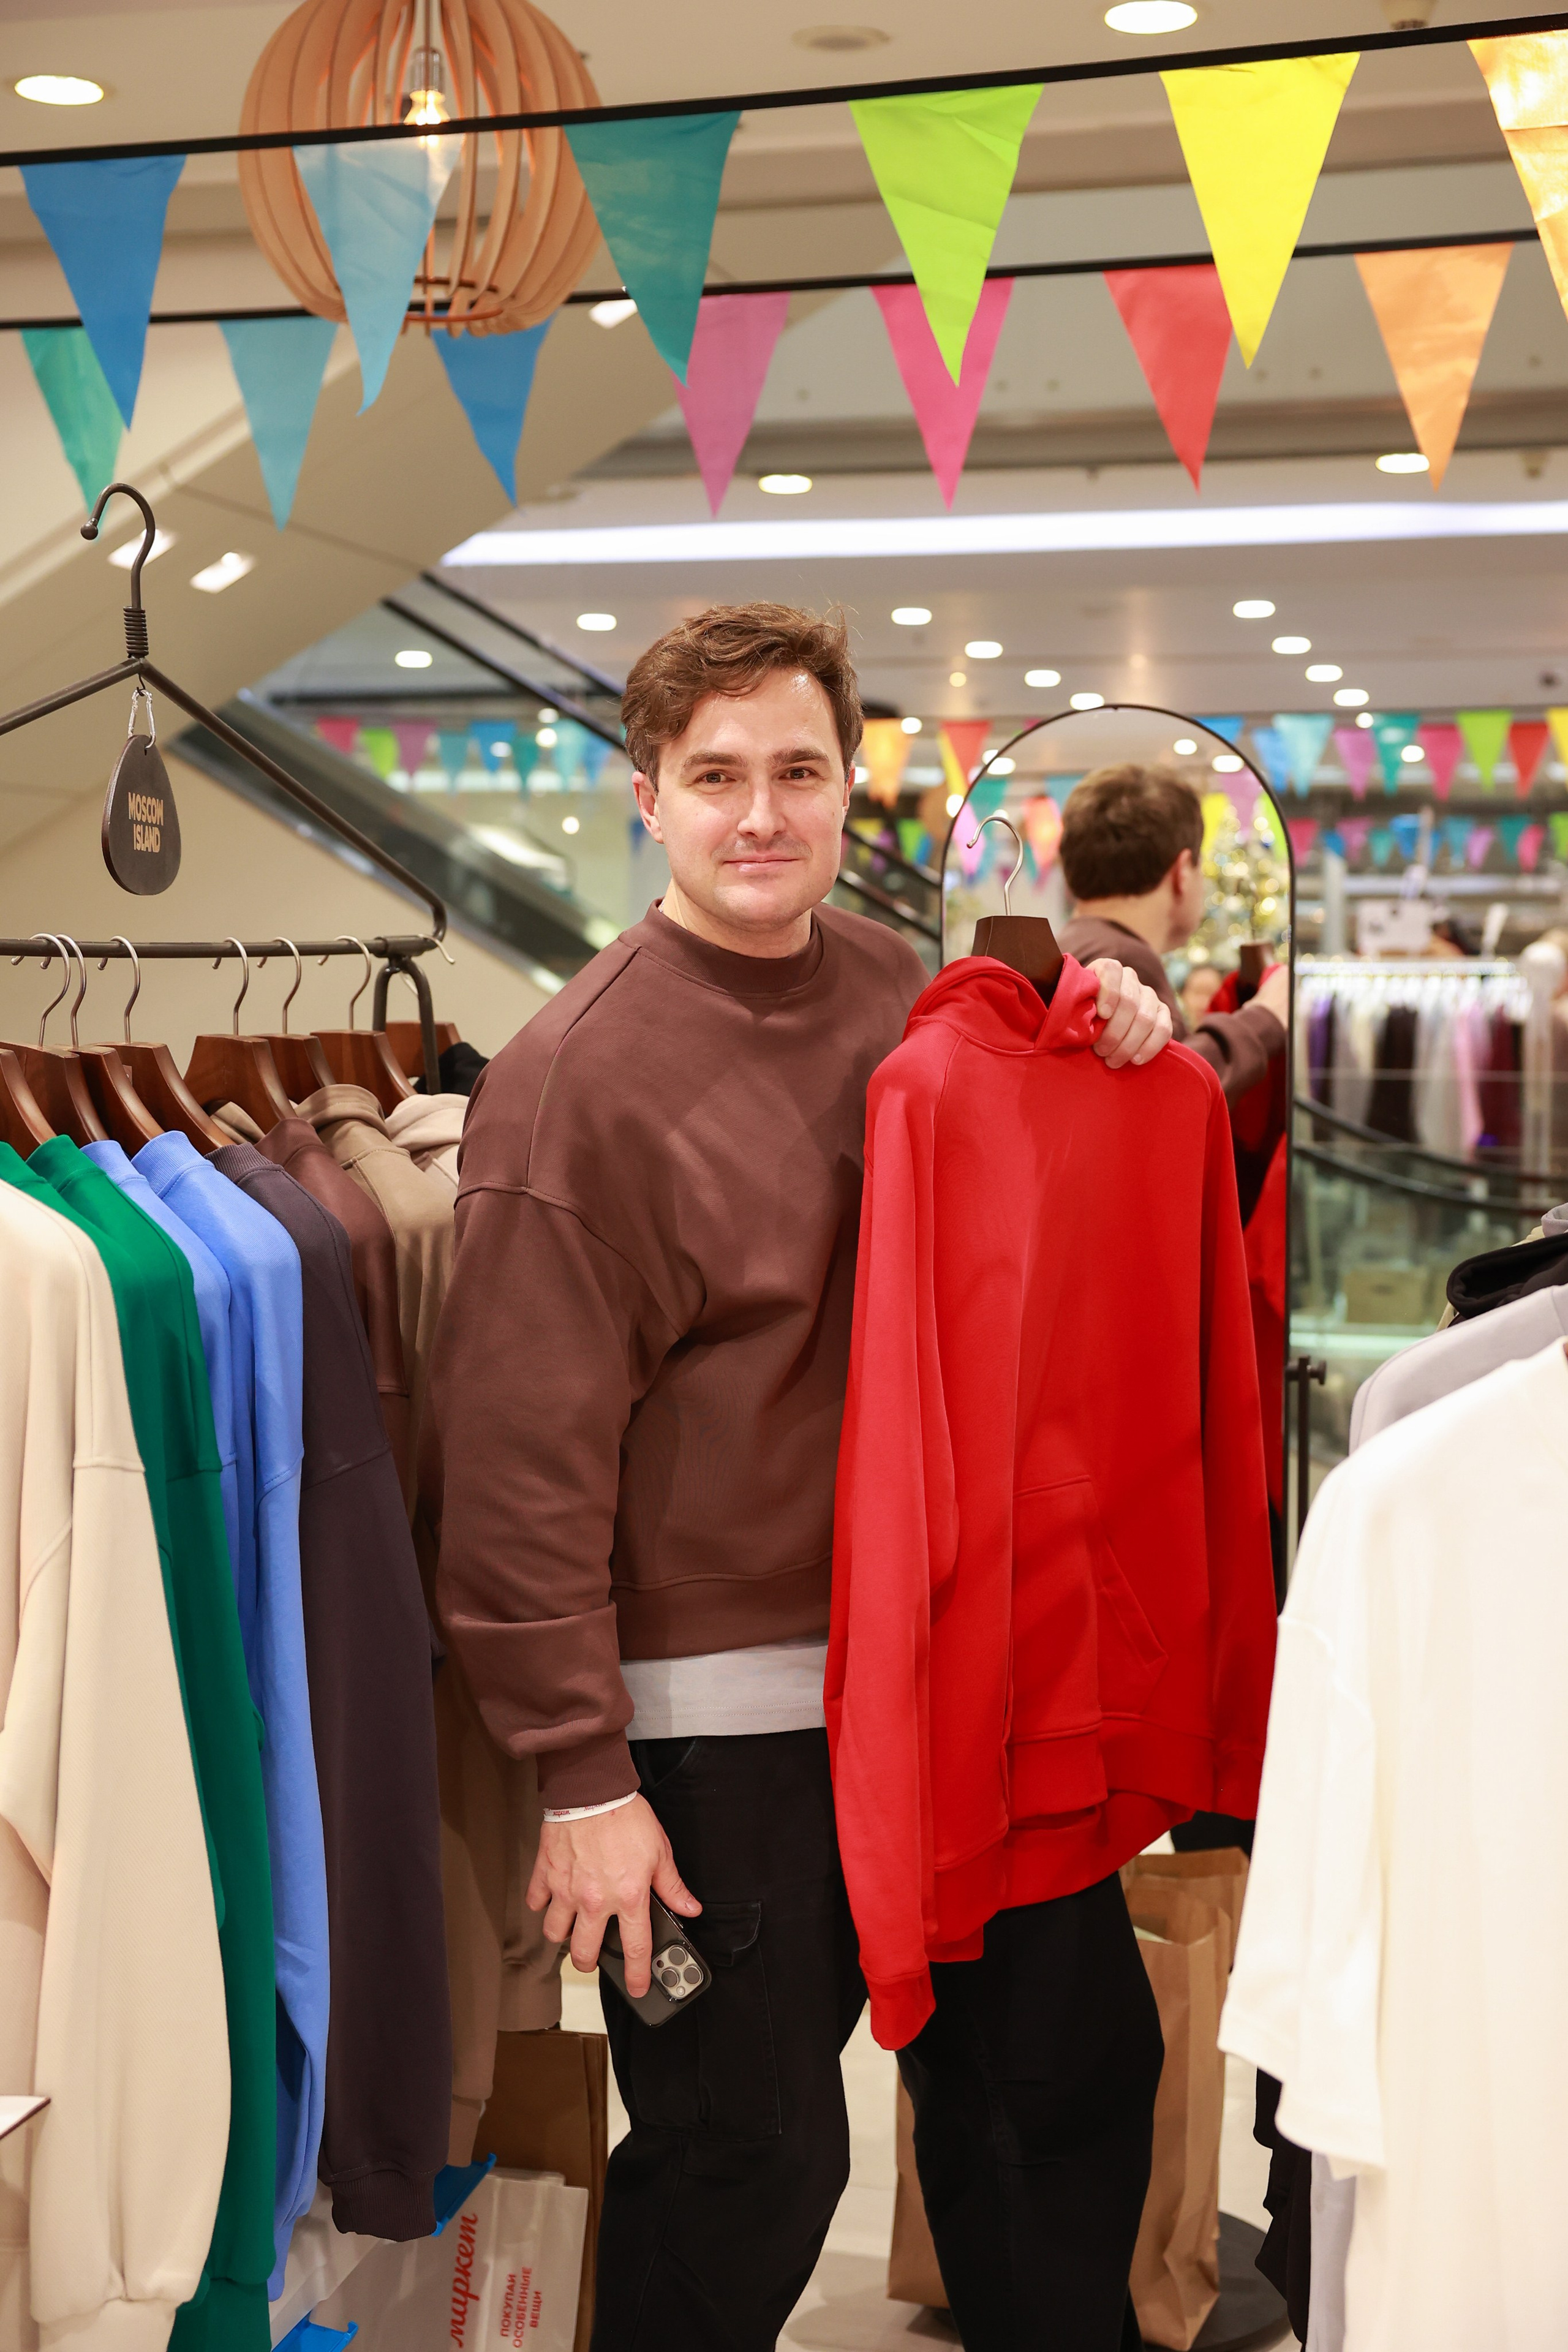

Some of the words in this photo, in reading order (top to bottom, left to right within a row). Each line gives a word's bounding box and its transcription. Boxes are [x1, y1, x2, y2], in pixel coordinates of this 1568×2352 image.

[128, 792, 164, 826] MOSCOW
[134, 824, 160, 853] ISLAND
[450, 2213, 480, 2348] маркет
[500, 2274, 516, 2337] ПОКУПАЙ
[513, 2267, 532, 2348] ОСОБЕННЫЕ
[530, 2291, 543, 2328] ВЕЩИ
